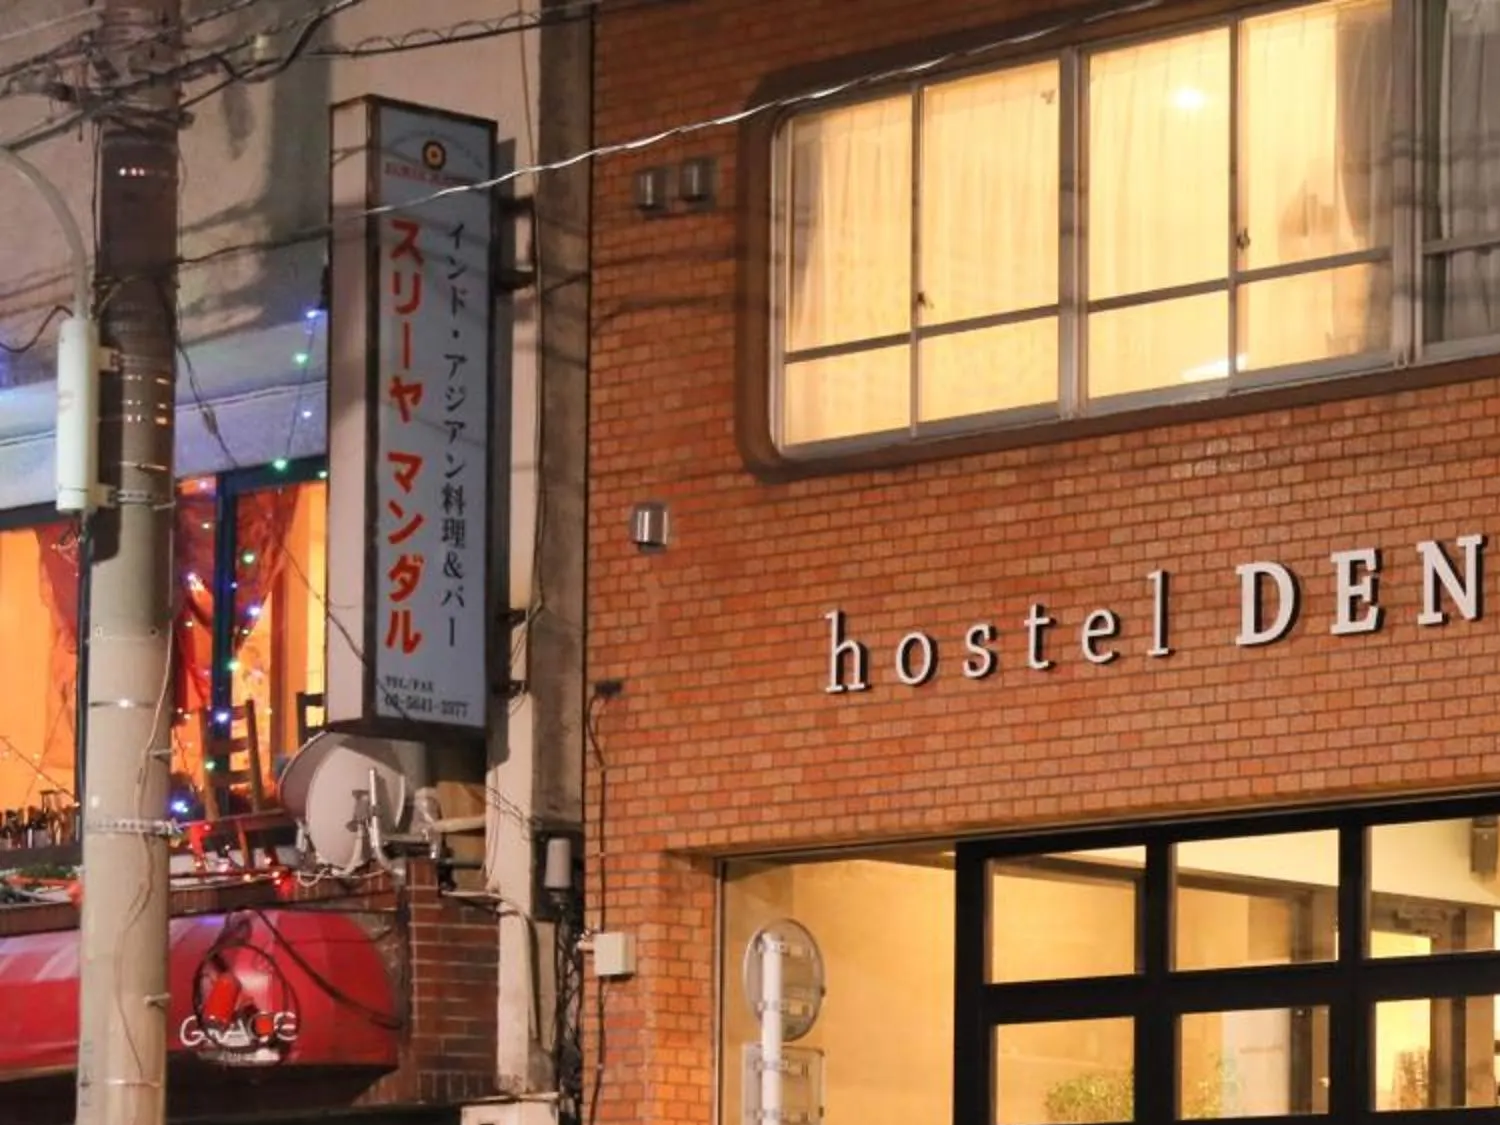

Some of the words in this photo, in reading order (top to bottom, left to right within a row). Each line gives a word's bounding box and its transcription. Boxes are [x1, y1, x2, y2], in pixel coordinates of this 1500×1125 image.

[389, 217, 425, 425] スリーヤ
[385, 450, 425, 656] マンダル
[824, 569, 1175, 693] hostel
[1234, 533, 1488, 652] DEN
